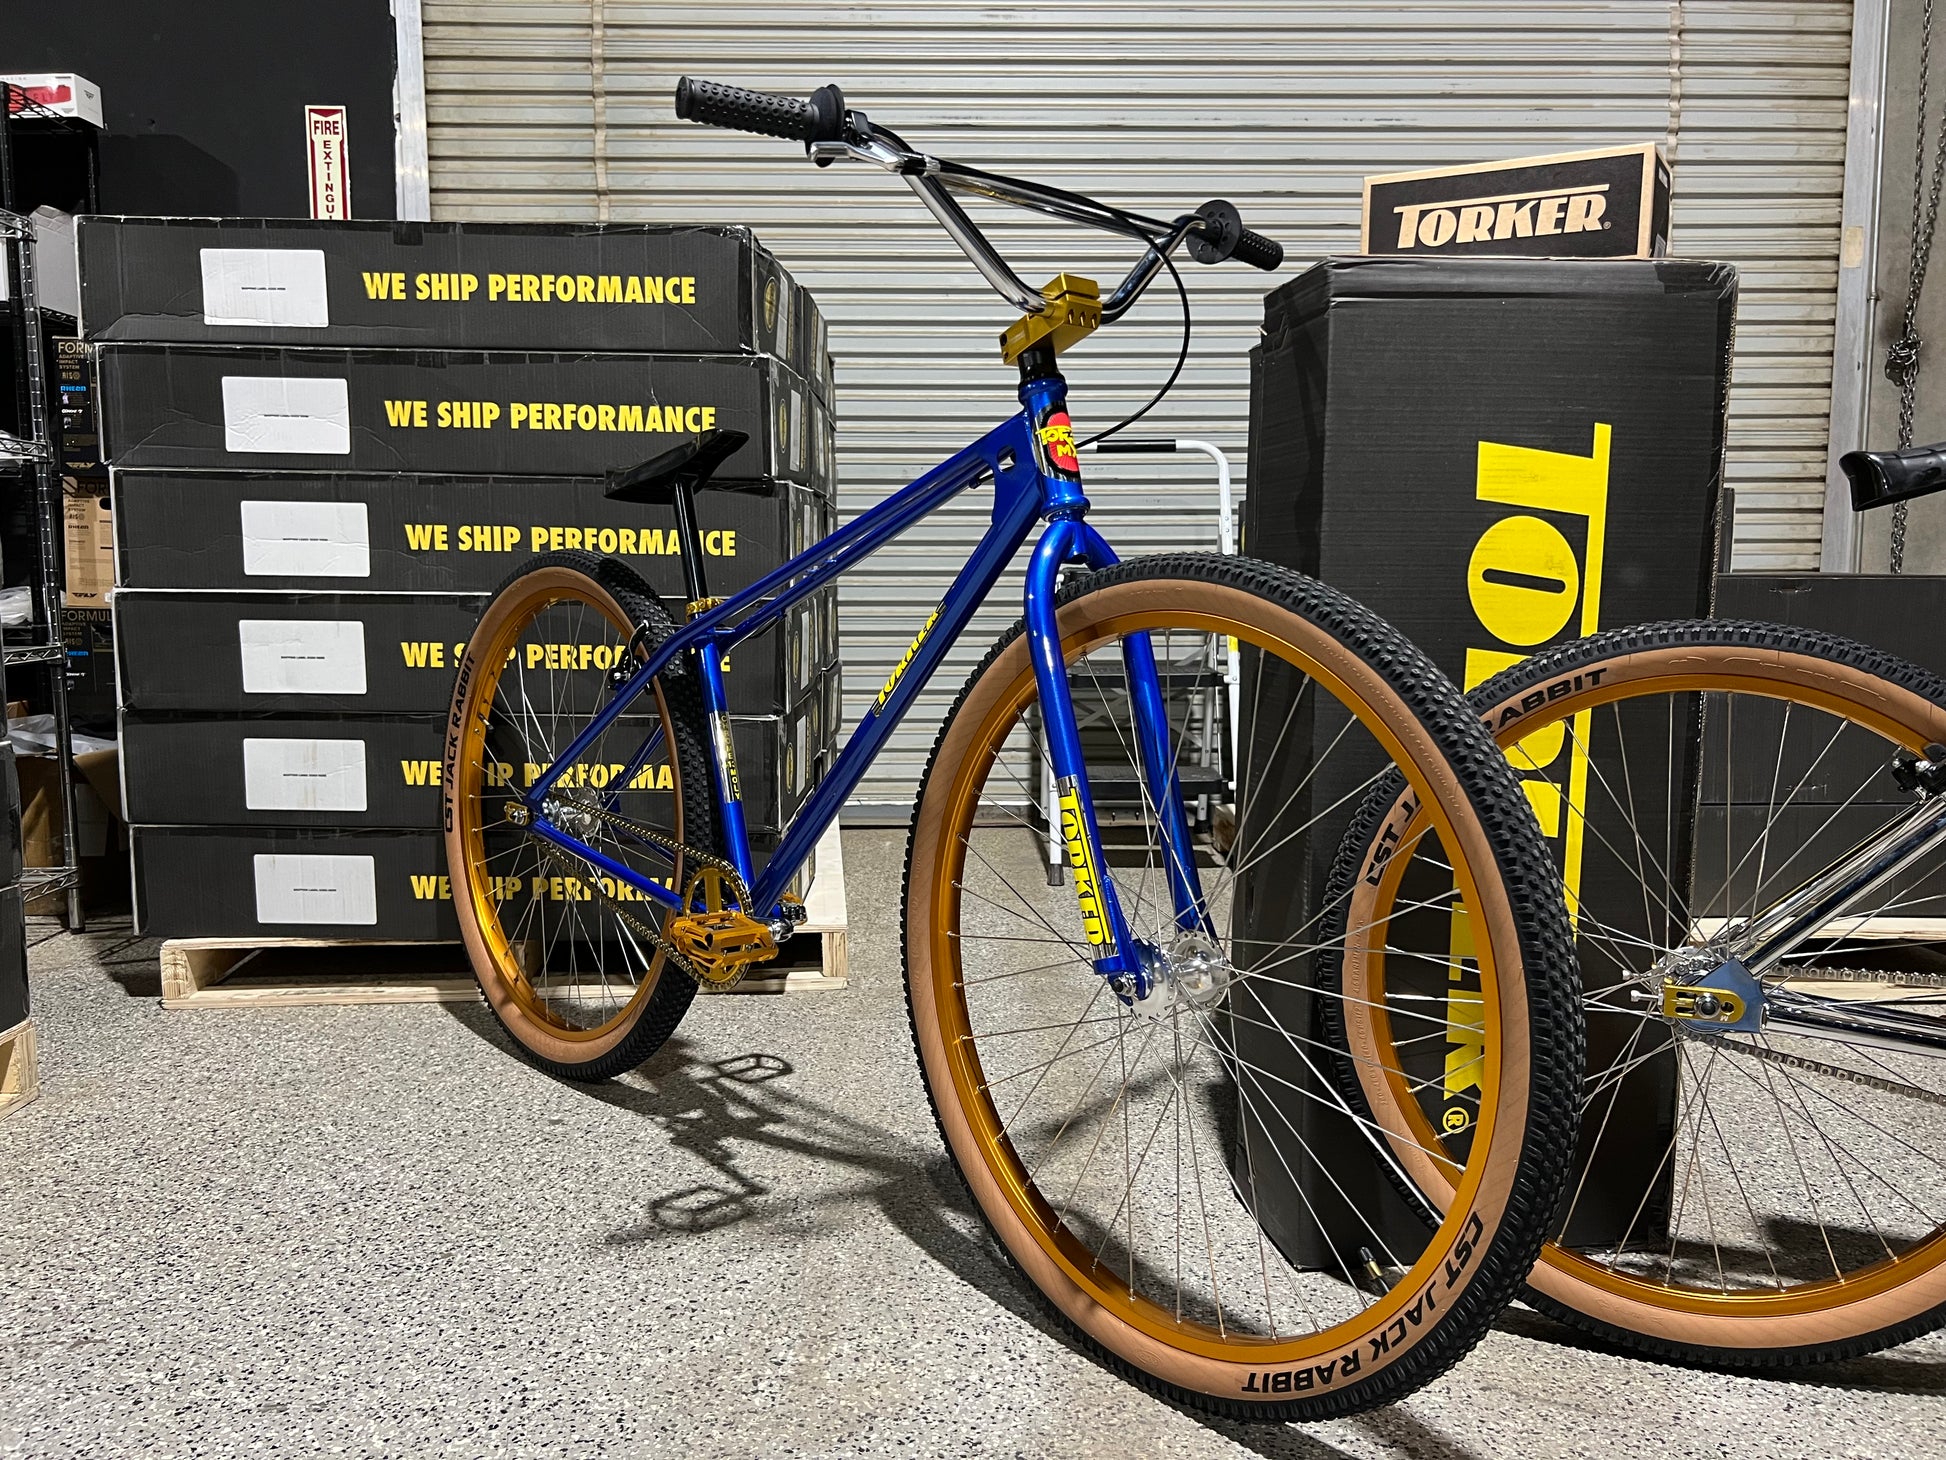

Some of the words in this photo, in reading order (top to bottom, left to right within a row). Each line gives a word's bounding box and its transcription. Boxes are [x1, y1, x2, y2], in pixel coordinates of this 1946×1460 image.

[313, 120, 340, 135] FIRE
[362, 272, 407, 300] WE
[415, 273, 479, 301] SHIP
[488, 274, 696, 304] PERFORMANCE
[384, 400, 428, 428] WE
[437, 401, 501, 429] SHIP
[510, 402, 716, 433] PERFORMANCE
[405, 524, 449, 551] WE
[457, 525, 521, 552] SHIP
[530, 526, 736, 557] PERFORMACE
[401, 641, 445, 668] WE
[451, 651, 476, 730] RABBIT
[401, 760, 443, 786] WE
[445, 735, 459, 791] JACK
[445, 793, 454, 833] CST
[410, 875, 452, 900] WE
[1443, 1211, 1485, 1290] CST
[1367, 1279, 1437, 1363] JACK
[1241, 1347, 1362, 1394] RABBIT
